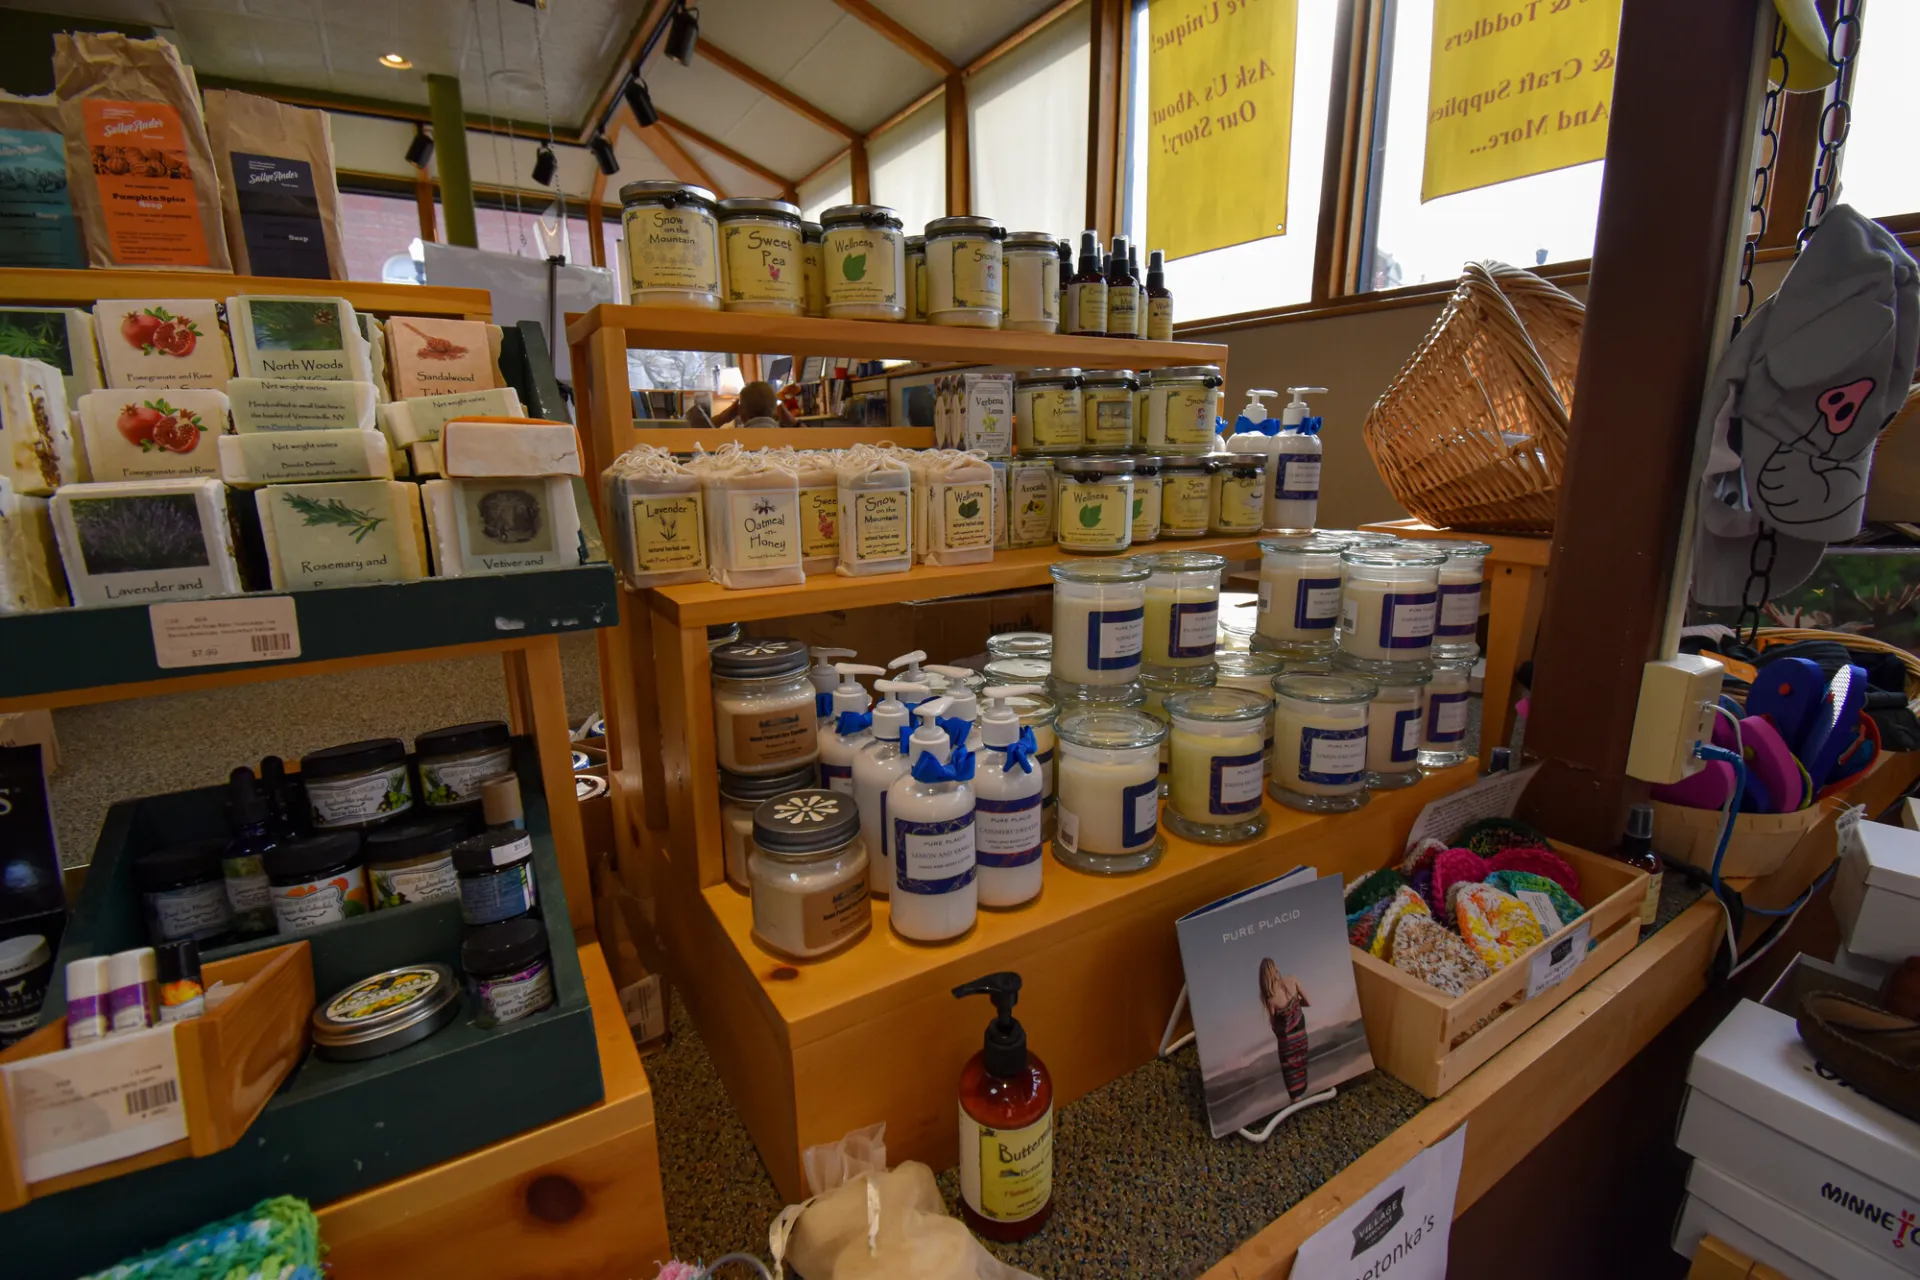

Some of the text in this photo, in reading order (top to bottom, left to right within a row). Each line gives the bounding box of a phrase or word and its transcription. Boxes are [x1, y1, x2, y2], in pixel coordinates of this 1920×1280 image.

[653, 212, 684, 228] Snow
[664, 226, 689, 235] on the
[649, 233, 695, 246] Mountain
[747, 230, 792, 252] Sweet
[835, 236, 875, 253] Wellness
[761, 250, 786, 267] Pea
[263, 359, 344, 371] North Woods
[416, 371, 475, 382] Sandalwood
[975, 397, 1004, 407] Verbena
[1021, 484, 1047, 493] Avocado
[864, 496, 897, 512] Snow
[954, 490, 984, 503] Wellness
[1073, 491, 1109, 503] Wellness
[646, 502, 688, 518] Lavender
[744, 514, 785, 533] Oatmeal
[864, 514, 899, 525] Mountain
[749, 534, 786, 552] Honey
[300, 554, 388, 575] Rosemary and
[483, 555, 545, 570] Vetiver and
[104, 578, 204, 600] Lavender and
[924, 840, 942, 848] PURE
[911, 852, 936, 860] LEMON
[937, 849, 953, 858] AND
[1222, 909, 1301, 944] PURE PLACID
[1359, 1199, 1399, 1238] VILLAGE
